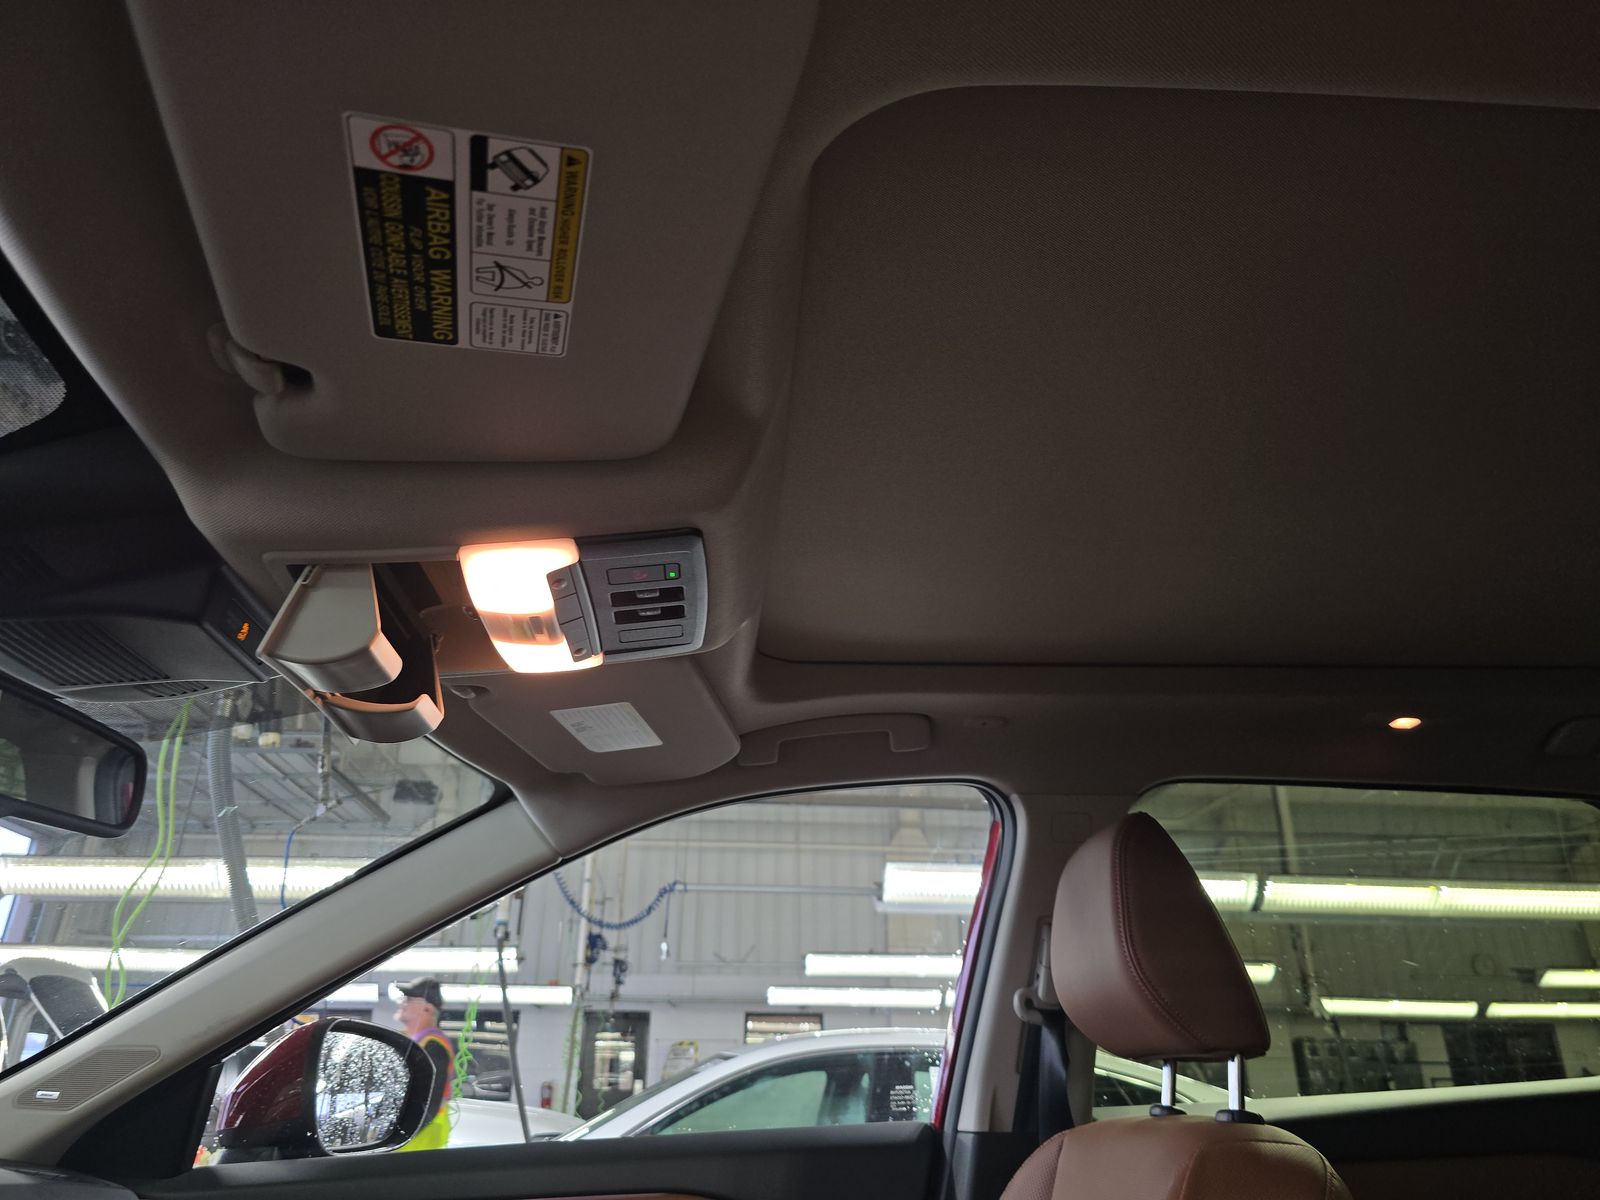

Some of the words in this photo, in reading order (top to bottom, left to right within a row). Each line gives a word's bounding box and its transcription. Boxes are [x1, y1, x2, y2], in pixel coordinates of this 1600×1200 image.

[378, 171, 403, 219] COUSSIN
[408, 225, 423, 250] FLIP
[424, 186, 450, 260] AIRBAG
[557, 218, 571, 245] HIGHER
[383, 220, 408, 275] GONFLABLE
[553, 247, 567, 282] ROLLOVER
[411, 253, 425, 282] VISOR
[389, 276, 413, 338] AVERTISSEMENT
[413, 285, 427, 311] OVER
[429, 267, 453, 340] WARNING
[551, 284, 563, 299] RISK
